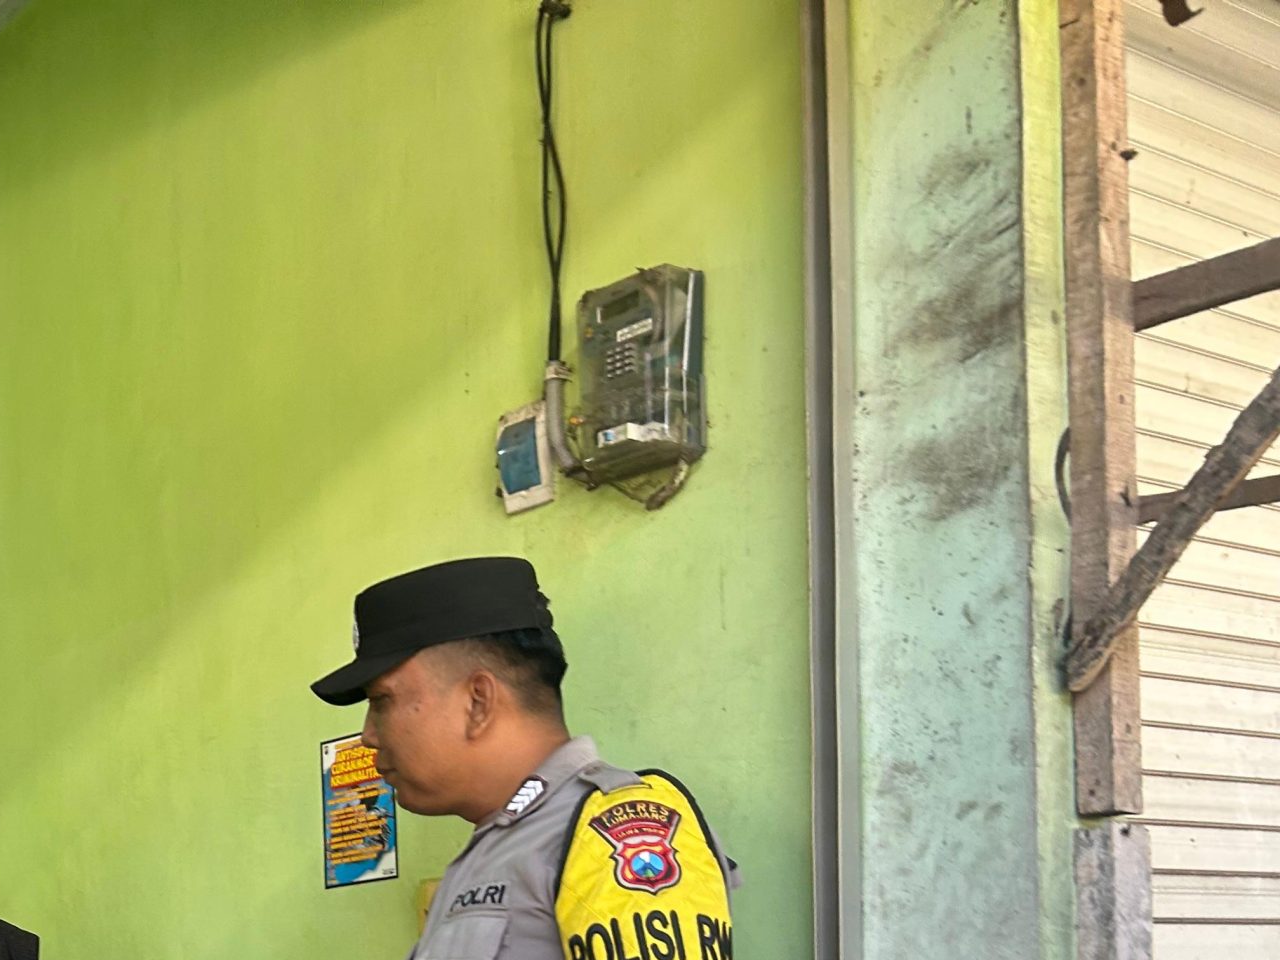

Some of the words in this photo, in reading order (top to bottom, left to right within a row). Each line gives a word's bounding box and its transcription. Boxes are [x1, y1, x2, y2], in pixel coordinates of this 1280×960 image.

[601, 803, 669, 823] POLRES
[605, 811, 668, 827] LUMAJANG
[450, 884, 506, 912] POLRI
